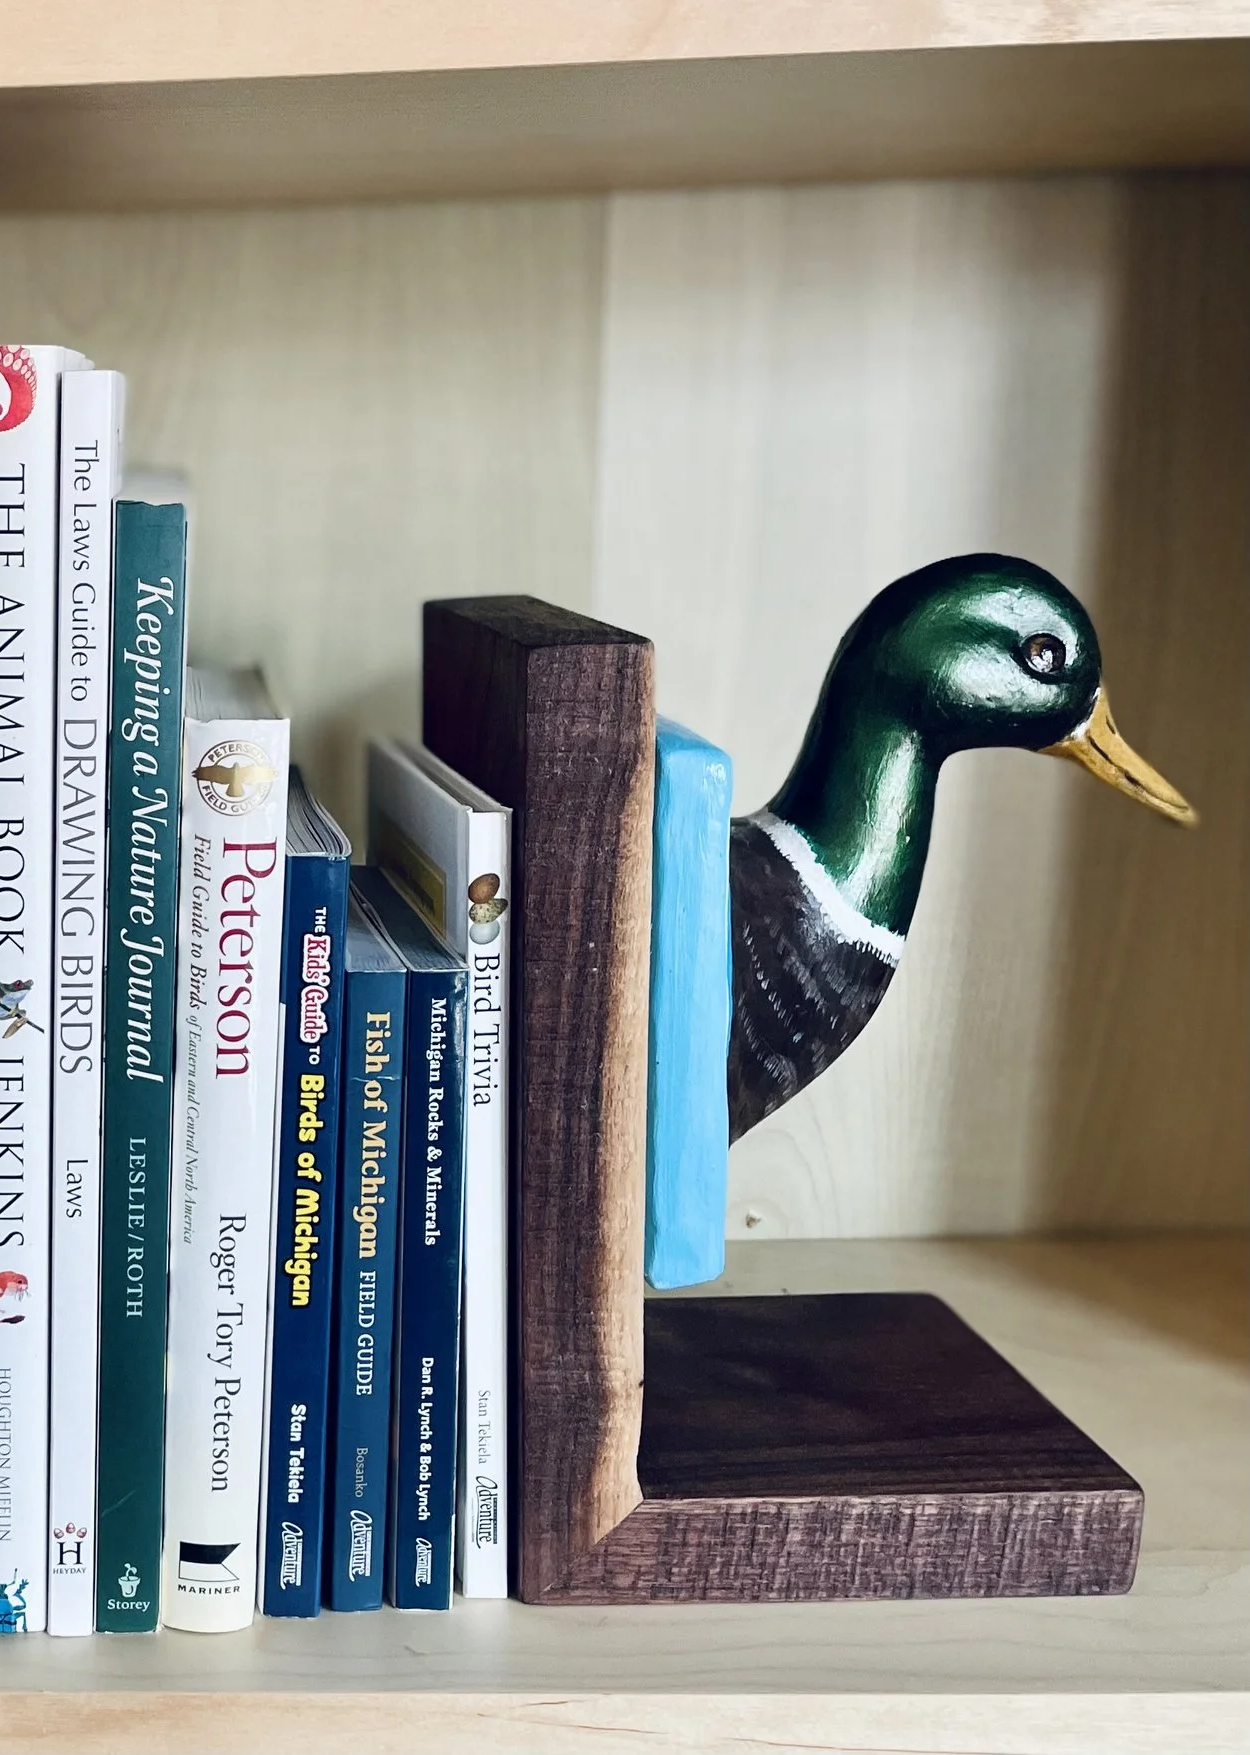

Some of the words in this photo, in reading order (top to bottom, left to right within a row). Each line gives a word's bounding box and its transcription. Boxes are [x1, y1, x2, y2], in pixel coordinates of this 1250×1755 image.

[74, 439, 100, 491] The
[72, 503, 97, 571] Laws
[71, 582, 97, 667] Guide
[70, 674, 92, 702] to
[121, 576, 174, 748] Keeping
[132, 751, 159, 777] a
[202, 785, 227, 811] FIELD
[61, 719, 97, 937] DRAWING
[130, 785, 168, 926] Nature
[193, 834, 211, 889] Field
[192, 887, 210, 940] Guide
[315, 907, 327, 933] THE
[191, 943, 204, 959] to
[215, 837, 278, 1079] Peterson
[120, 928, 164, 1083] Journal
[189, 963, 207, 1010] Birds
[473, 953, 502, 1014] Bird
[59, 955, 94, 1074] BIRDS
[185, 1014, 202, 1031] of
[303, 988, 326, 1040] Guide
[426, 998, 447, 1082] Michigan
[187, 1029, 201, 1075] Eastern
[308, 1046, 320, 1064] TO
[366, 1012, 391, 1073] Fish
[473, 1024, 501, 1107] Trivia
[187, 1079, 200, 1104] and
[299, 1074, 325, 1143] Birds
[364, 1080, 388, 1113] of
[427, 1087, 444, 1141] Rocks
[186, 1106, 199, 1155] Central
[427, 1146, 443, 1161] &
[66, 1159, 89, 1218] Laws
[185, 1154, 198, 1191] North
[297, 1152, 321, 1182] of
[353, 1121, 387, 1259] Michigan
[183, 1193, 196, 1244] America
[424, 1166, 443, 1246] Minerals
[210, 1213, 247, 1295] Roger
[285, 1189, 320, 1306] Michigan
[358, 1271, 375, 1326] FIELD
[207, 1303, 244, 1369] Tory
[356, 1334, 374, 1395] GUIDE
[422, 1357, 434, 1384] Dan
[421, 1387, 433, 1399] R.
[478, 1390, 491, 1417] Stan
[212, 1377, 241, 1491] Peterson
[290, 1404, 306, 1442] Stan
[418, 1402, 433, 1440] Lynch
[478, 1421, 491, 1465] Tekiela
[355, 1447, 368, 1498] Bosanko
[419, 1456, 431, 1481] Bob
[420, 1443, 431, 1453] &
[288, 1448, 305, 1504] Tekiela
[416, 1484, 431, 1521] Lynch
[476, 1476, 498, 1549] Adventure
[53, 1567, 87, 1575] HEYDAY
[57, 1541, 83, 1565] H
[280, 1522, 303, 1590] Adventure
[349, 1510, 372, 1581] Adventure
[107, 1598, 151, 1611] Storey
[178, 1585, 240, 1594] MARINER
